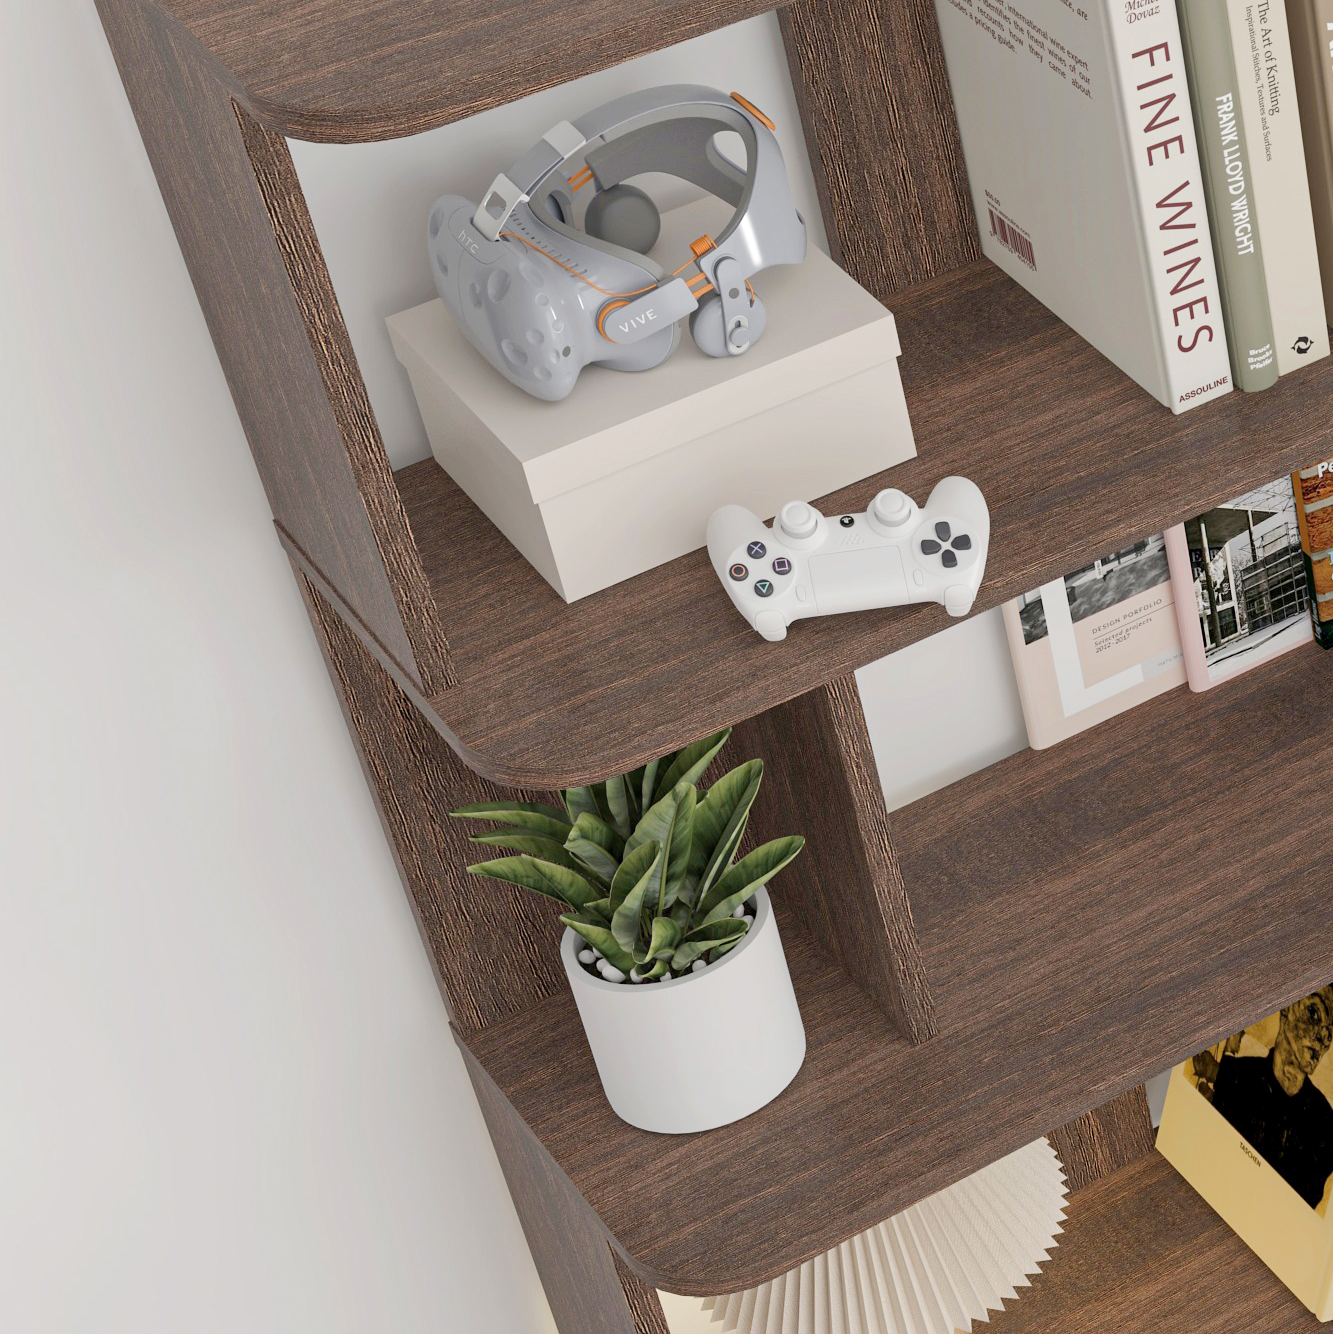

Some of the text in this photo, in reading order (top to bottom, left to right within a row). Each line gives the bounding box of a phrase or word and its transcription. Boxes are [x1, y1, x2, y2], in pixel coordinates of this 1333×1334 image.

[1126, 4, 1160, 25] Dovaz
[1258, 0, 1280, 115] The Art of Knitting
[1216, 92, 1254, 255] FRANK LLOYD WRIGHT
[1131, 41, 1214, 354] FINE WINES
[619, 309, 657, 333] VIVE
[1179, 376, 1228, 402] ASSOULINE
[1092, 598, 1162, 635] DESIGN PORFOLIO
[1238, 1141, 1262, 1168] TASCHEN
